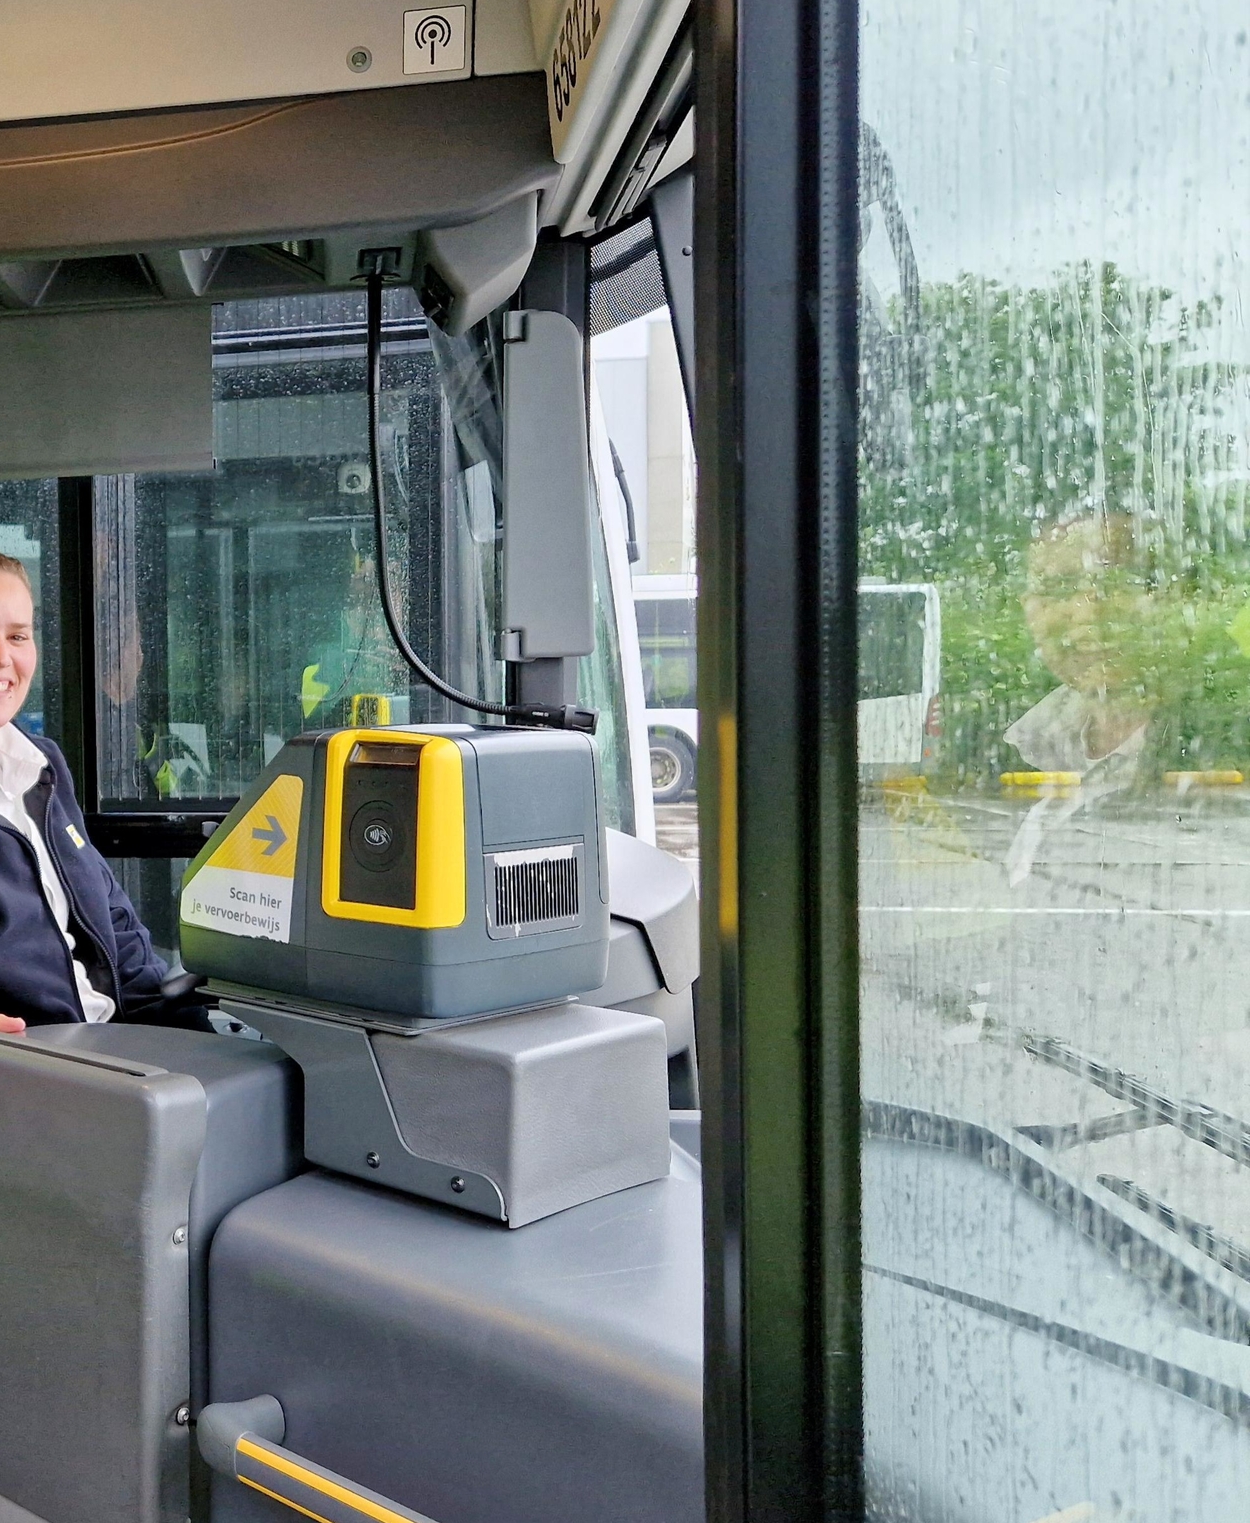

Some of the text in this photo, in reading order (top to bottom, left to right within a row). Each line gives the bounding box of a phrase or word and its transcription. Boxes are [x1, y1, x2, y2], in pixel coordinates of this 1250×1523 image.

[229, 887, 282, 910] Scan hier
[191, 898, 280, 933] je vervoerbewijs
